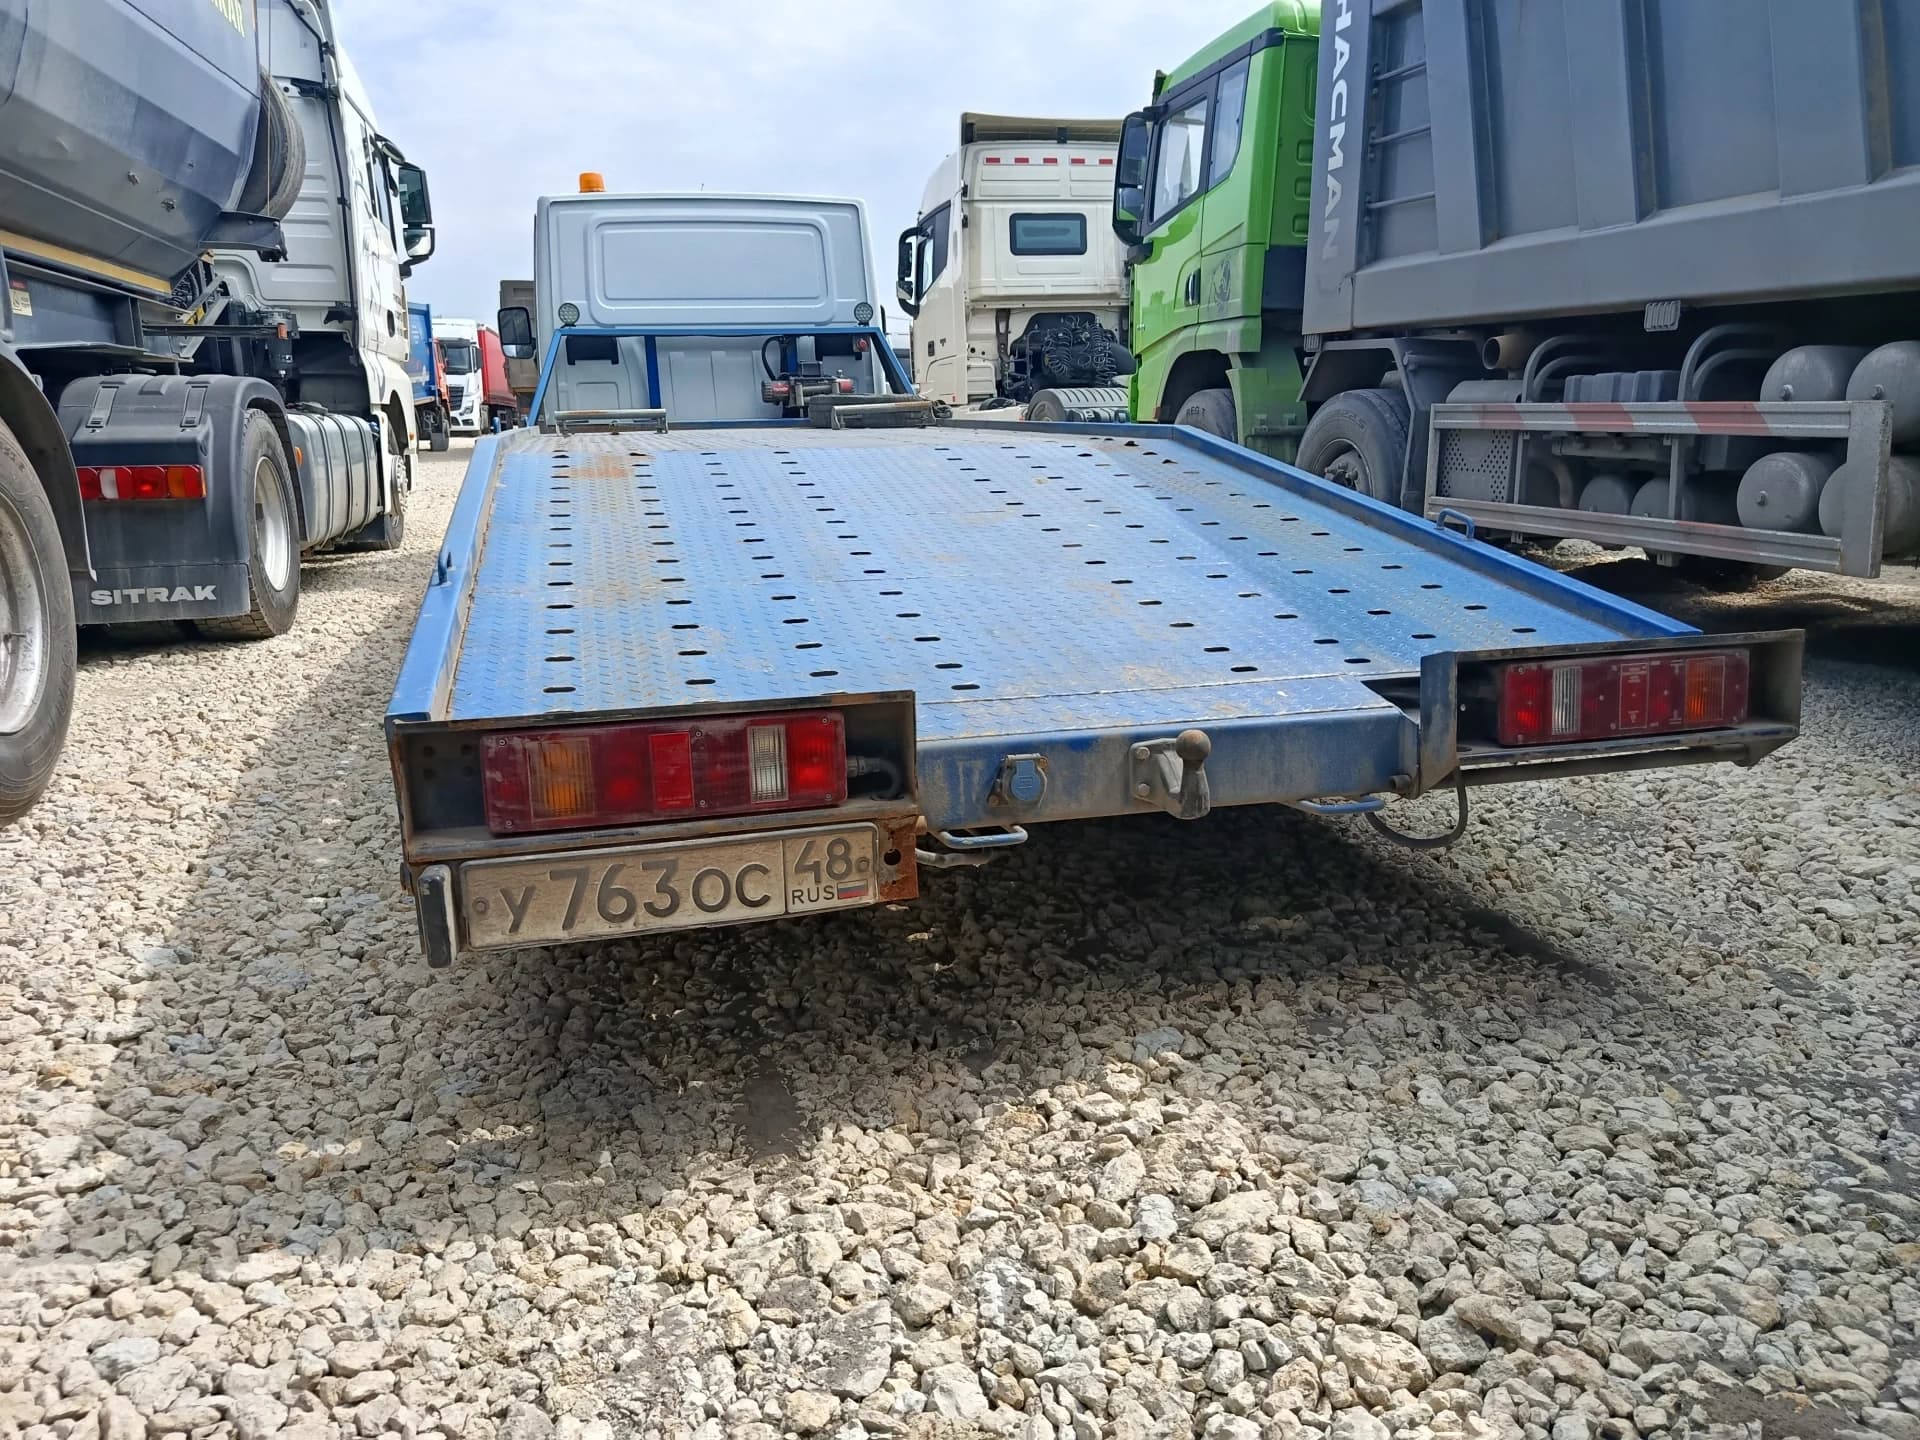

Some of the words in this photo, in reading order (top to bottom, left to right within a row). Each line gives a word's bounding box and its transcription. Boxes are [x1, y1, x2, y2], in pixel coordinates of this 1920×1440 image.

[90, 585, 217, 606] SITRAK
[793, 837, 854, 884] 48
[791, 884, 836, 905] RUS
